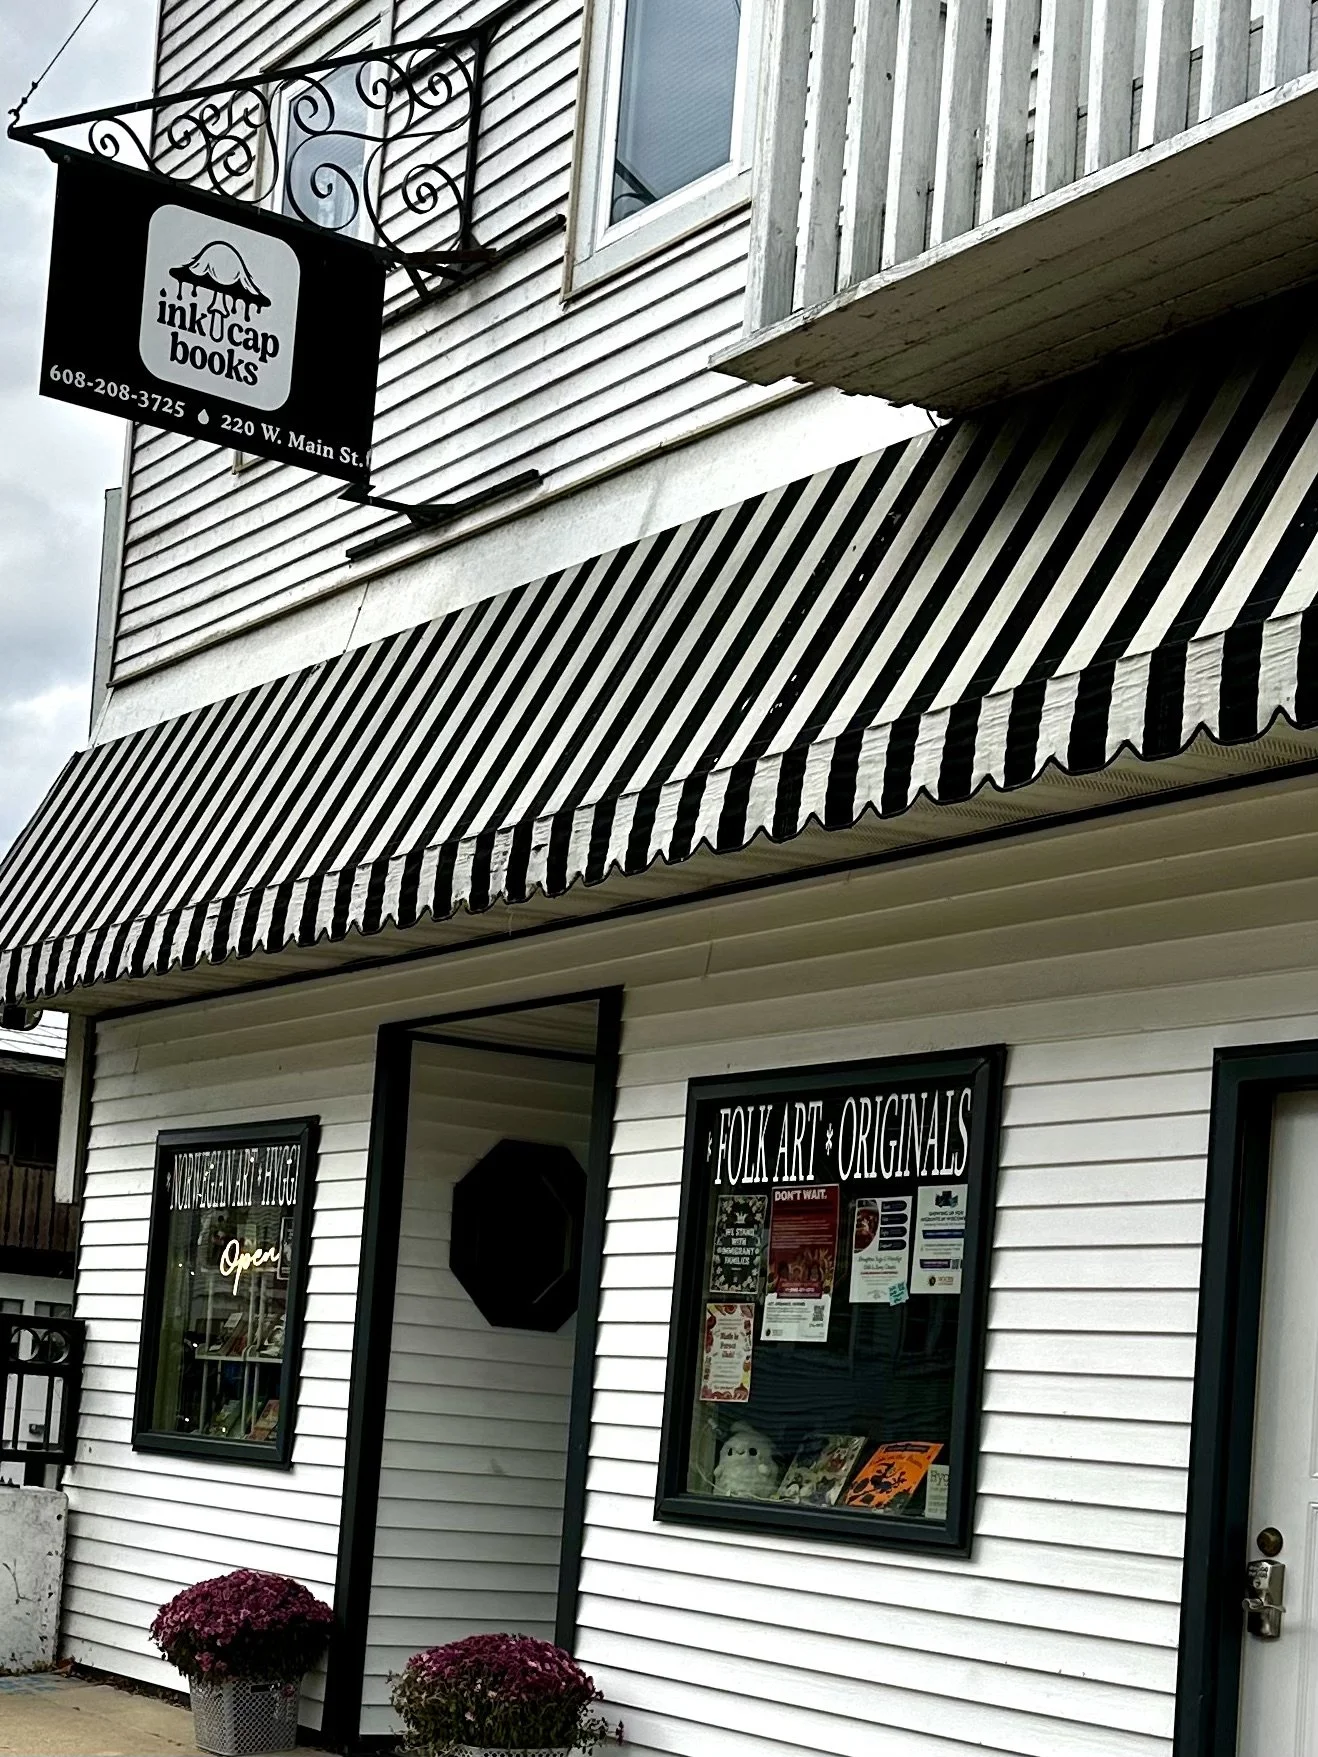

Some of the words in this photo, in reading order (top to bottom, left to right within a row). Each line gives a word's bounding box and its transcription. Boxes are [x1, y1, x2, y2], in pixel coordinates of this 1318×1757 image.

[157, 288, 207, 336] ink
[227, 323, 280, 363] cap
[170, 331, 258, 386] books
[49, 365, 186, 418] 608-208-3725
[221, 414, 255, 436] 220
[261, 423, 283, 445] W.
[288, 431, 335, 460] Main
[339, 446, 364, 468] St.
[714, 1104, 773, 1185] FOLK
[772, 1100, 824, 1183] ART
[838, 1087, 972, 1181] ORIGINALS
[170, 1149, 236, 1211] NORWEGIAN
[232, 1148, 259, 1207] ART
[774, 1190, 802, 1202] DON'T
[803, 1189, 828, 1200] WAIT.
[219, 1239, 281, 1296] Open
